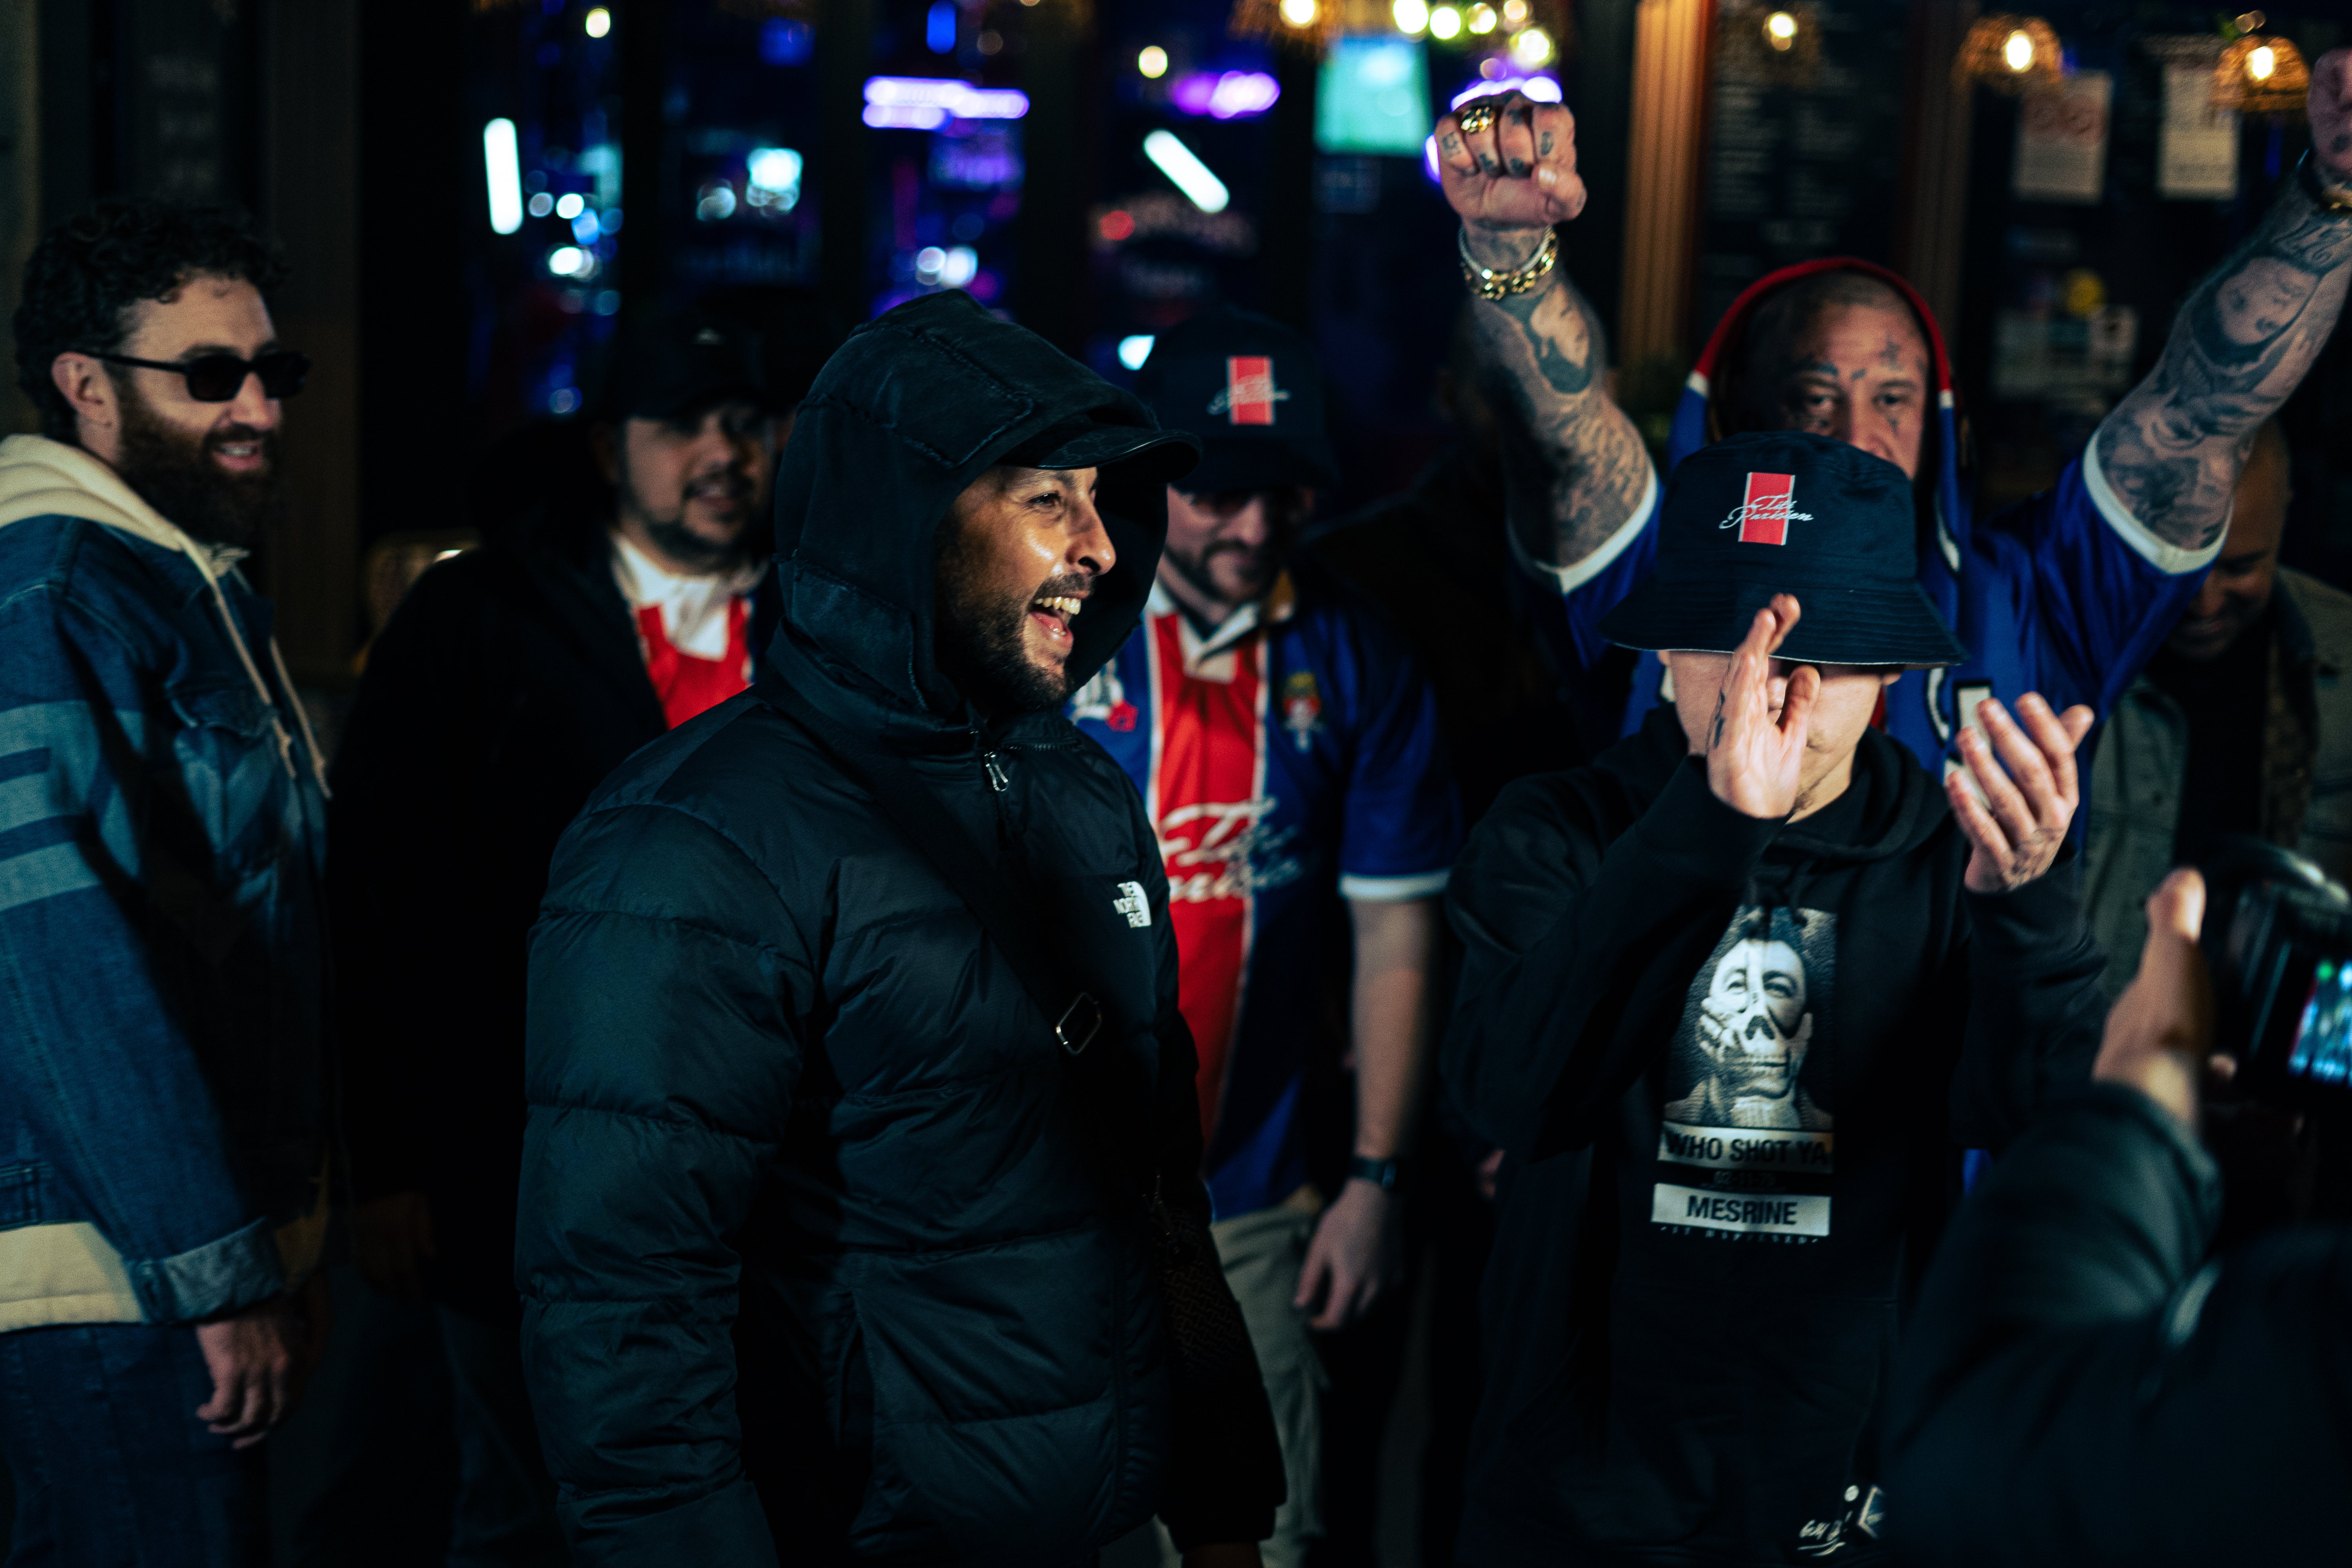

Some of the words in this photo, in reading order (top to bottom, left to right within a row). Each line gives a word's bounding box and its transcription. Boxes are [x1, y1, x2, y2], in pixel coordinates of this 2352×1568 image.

[1665, 1129, 1722, 1160] WHO
[1730, 1139, 1790, 1162] SHOT
[1797, 1141, 1828, 1165] YA
[1687, 1195, 1797, 1225] MESRINE
